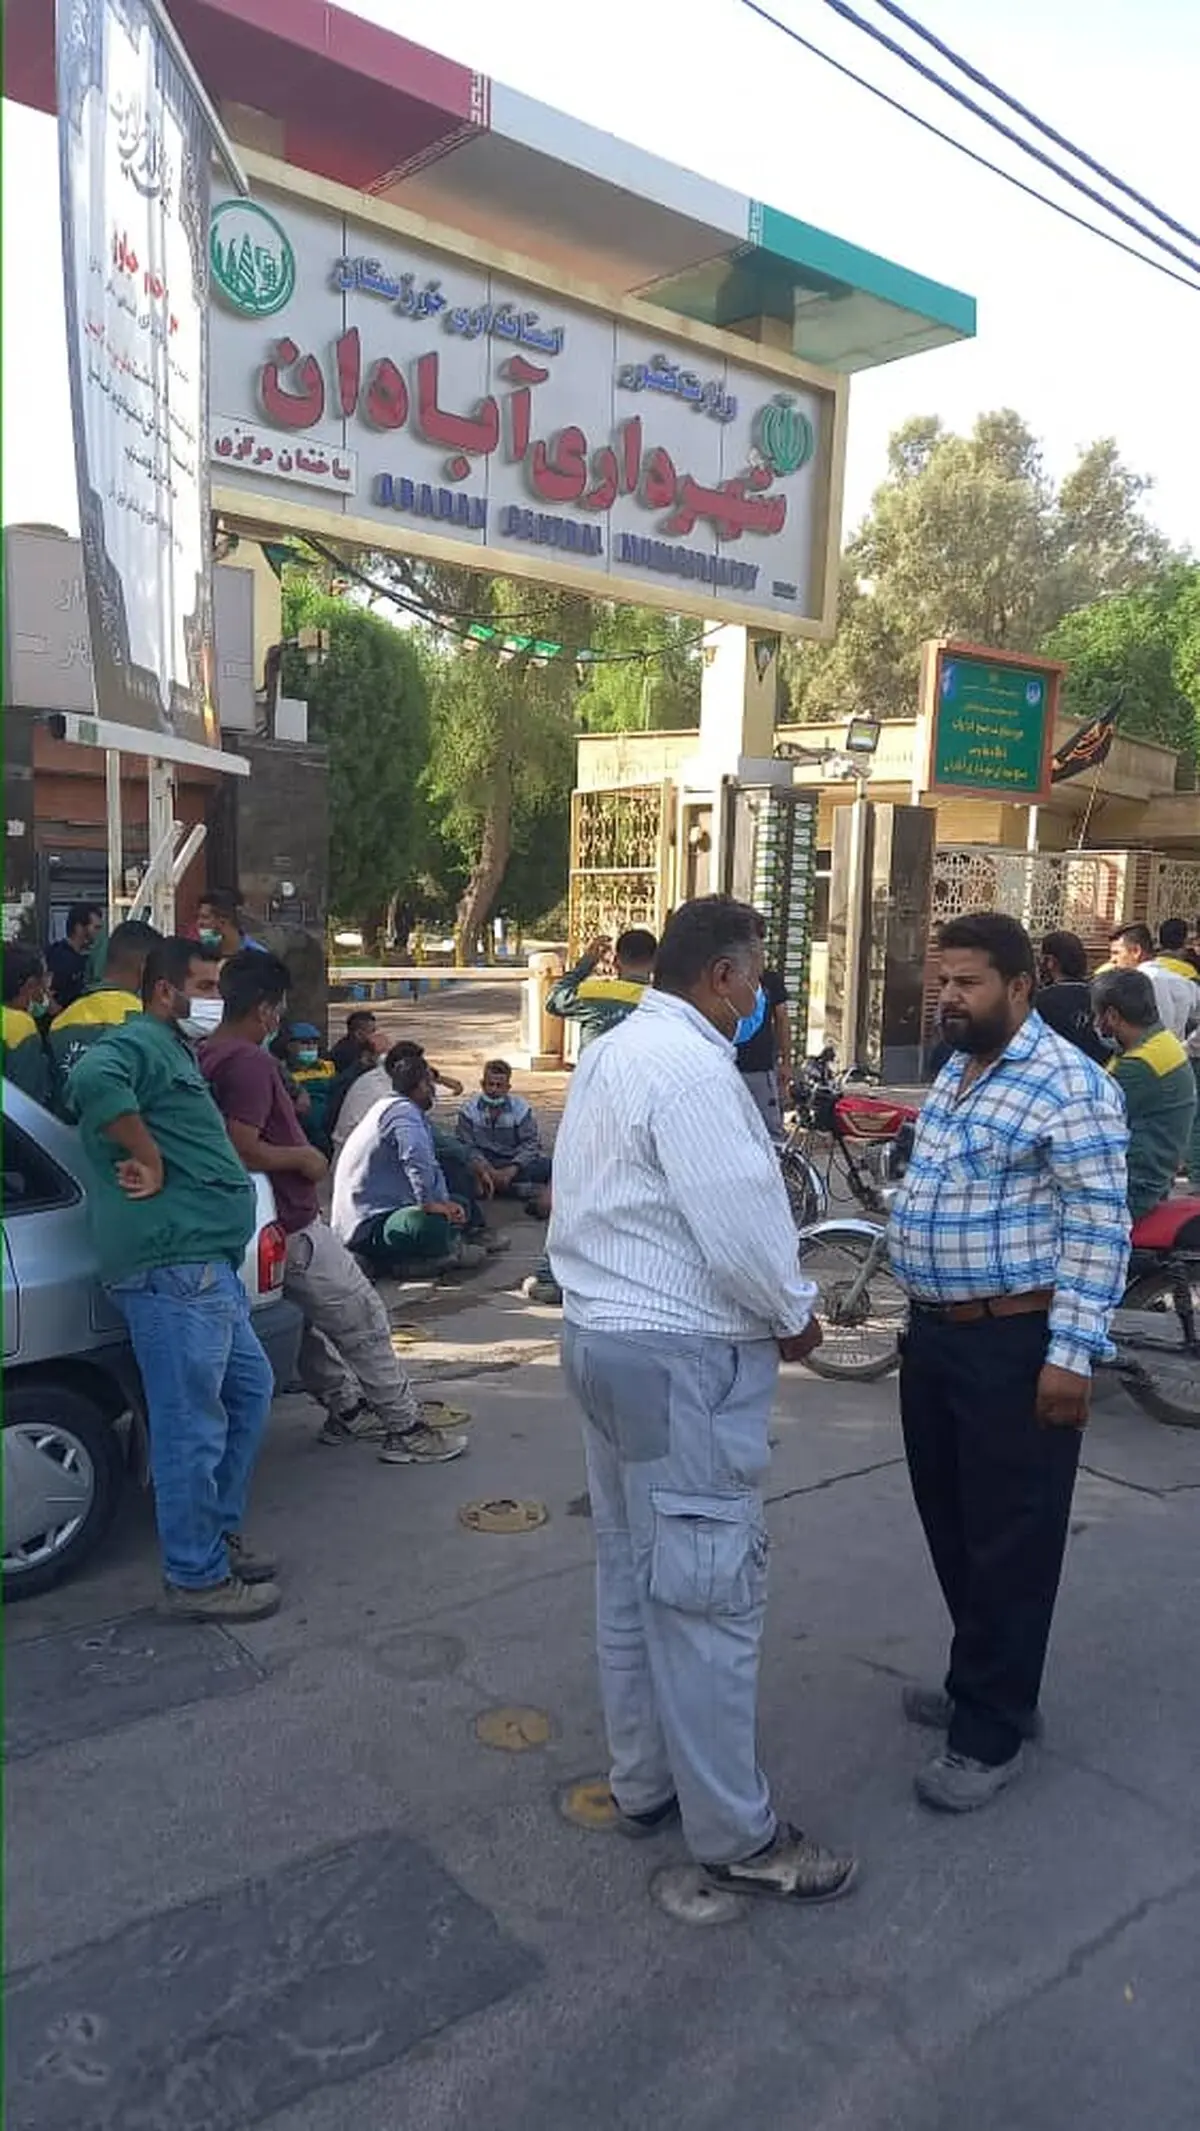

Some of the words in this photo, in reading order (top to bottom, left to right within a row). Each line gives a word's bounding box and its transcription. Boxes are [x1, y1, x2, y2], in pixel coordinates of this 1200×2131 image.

[331, 256, 447, 318] خوزستان
[450, 304, 565, 356] استانداری
[261, 325, 549, 482] آبادان
[214, 427, 274, 465] مرکزی
[277, 447, 351, 481] ساختمان
[373, 472, 488, 529] ABADAN
[531, 415, 787, 542] شهرداری
